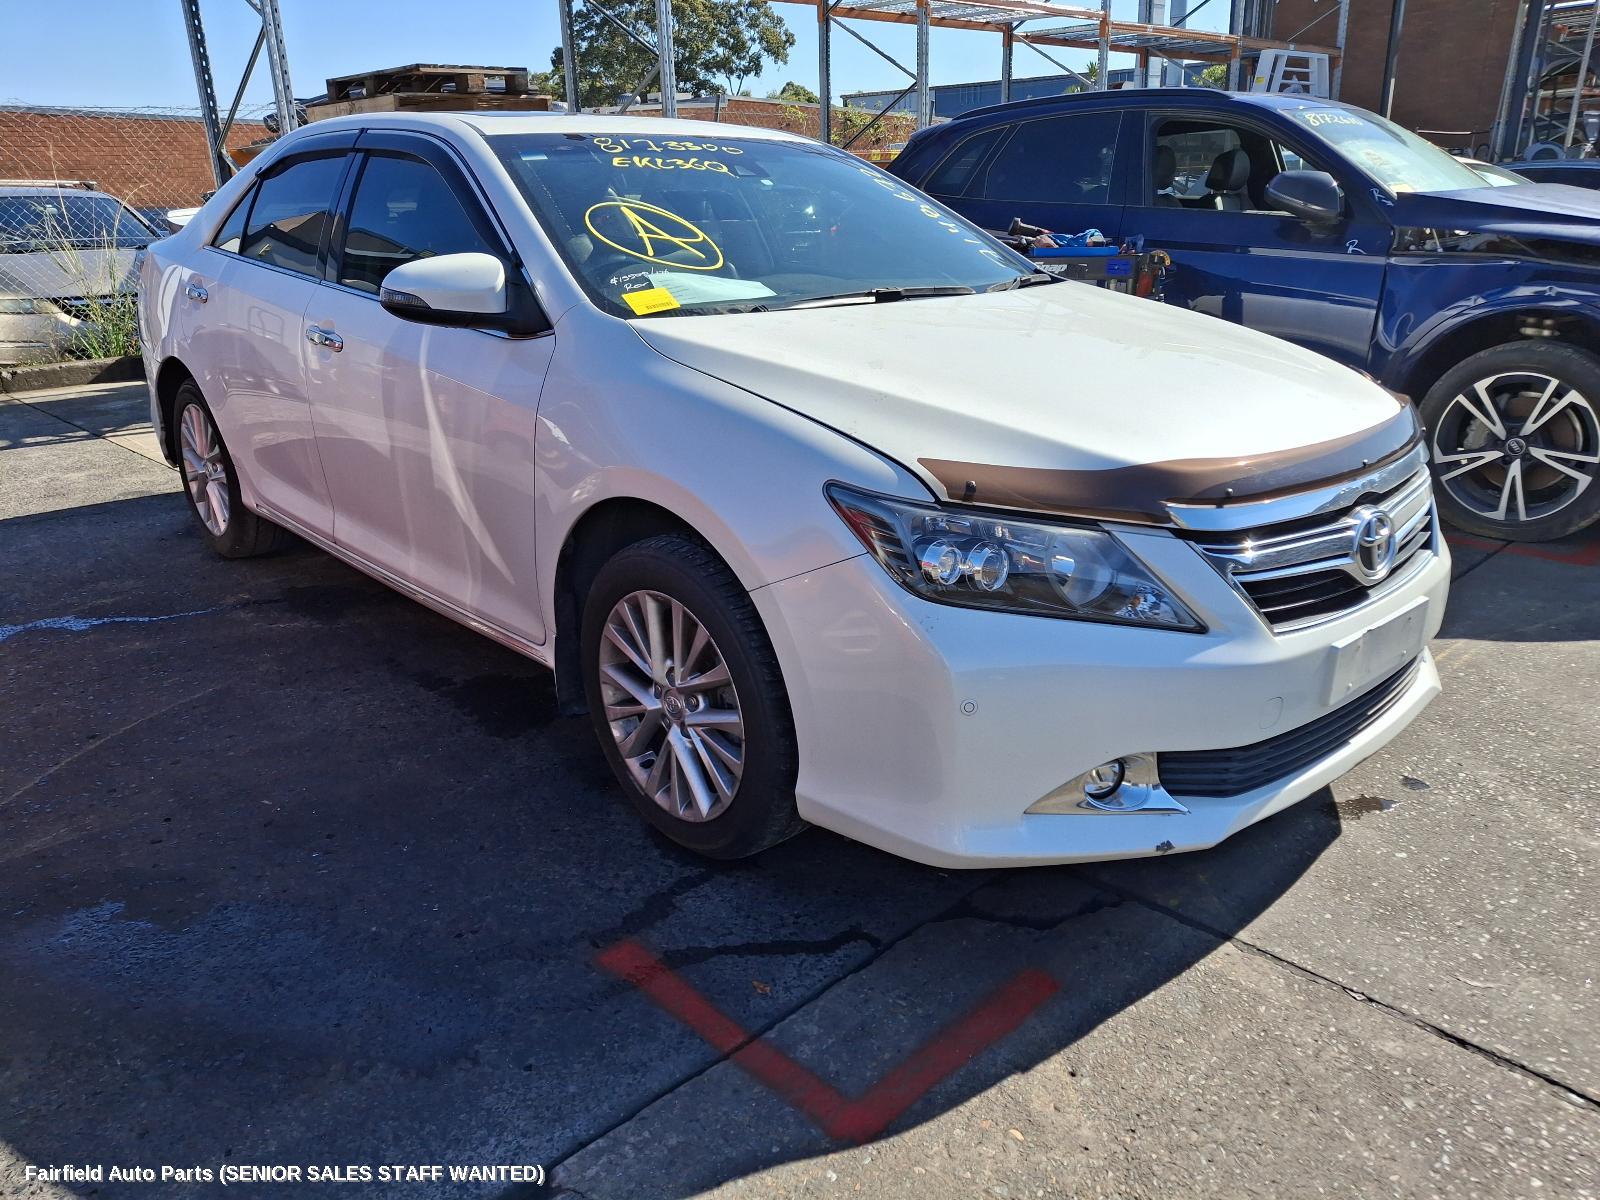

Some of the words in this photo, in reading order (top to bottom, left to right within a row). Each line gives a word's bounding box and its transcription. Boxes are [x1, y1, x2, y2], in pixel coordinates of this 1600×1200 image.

[593, 137, 745, 154] 8173300
[612, 156, 740, 179] EKL36Q
[1342, 236, 1367, 249] R
